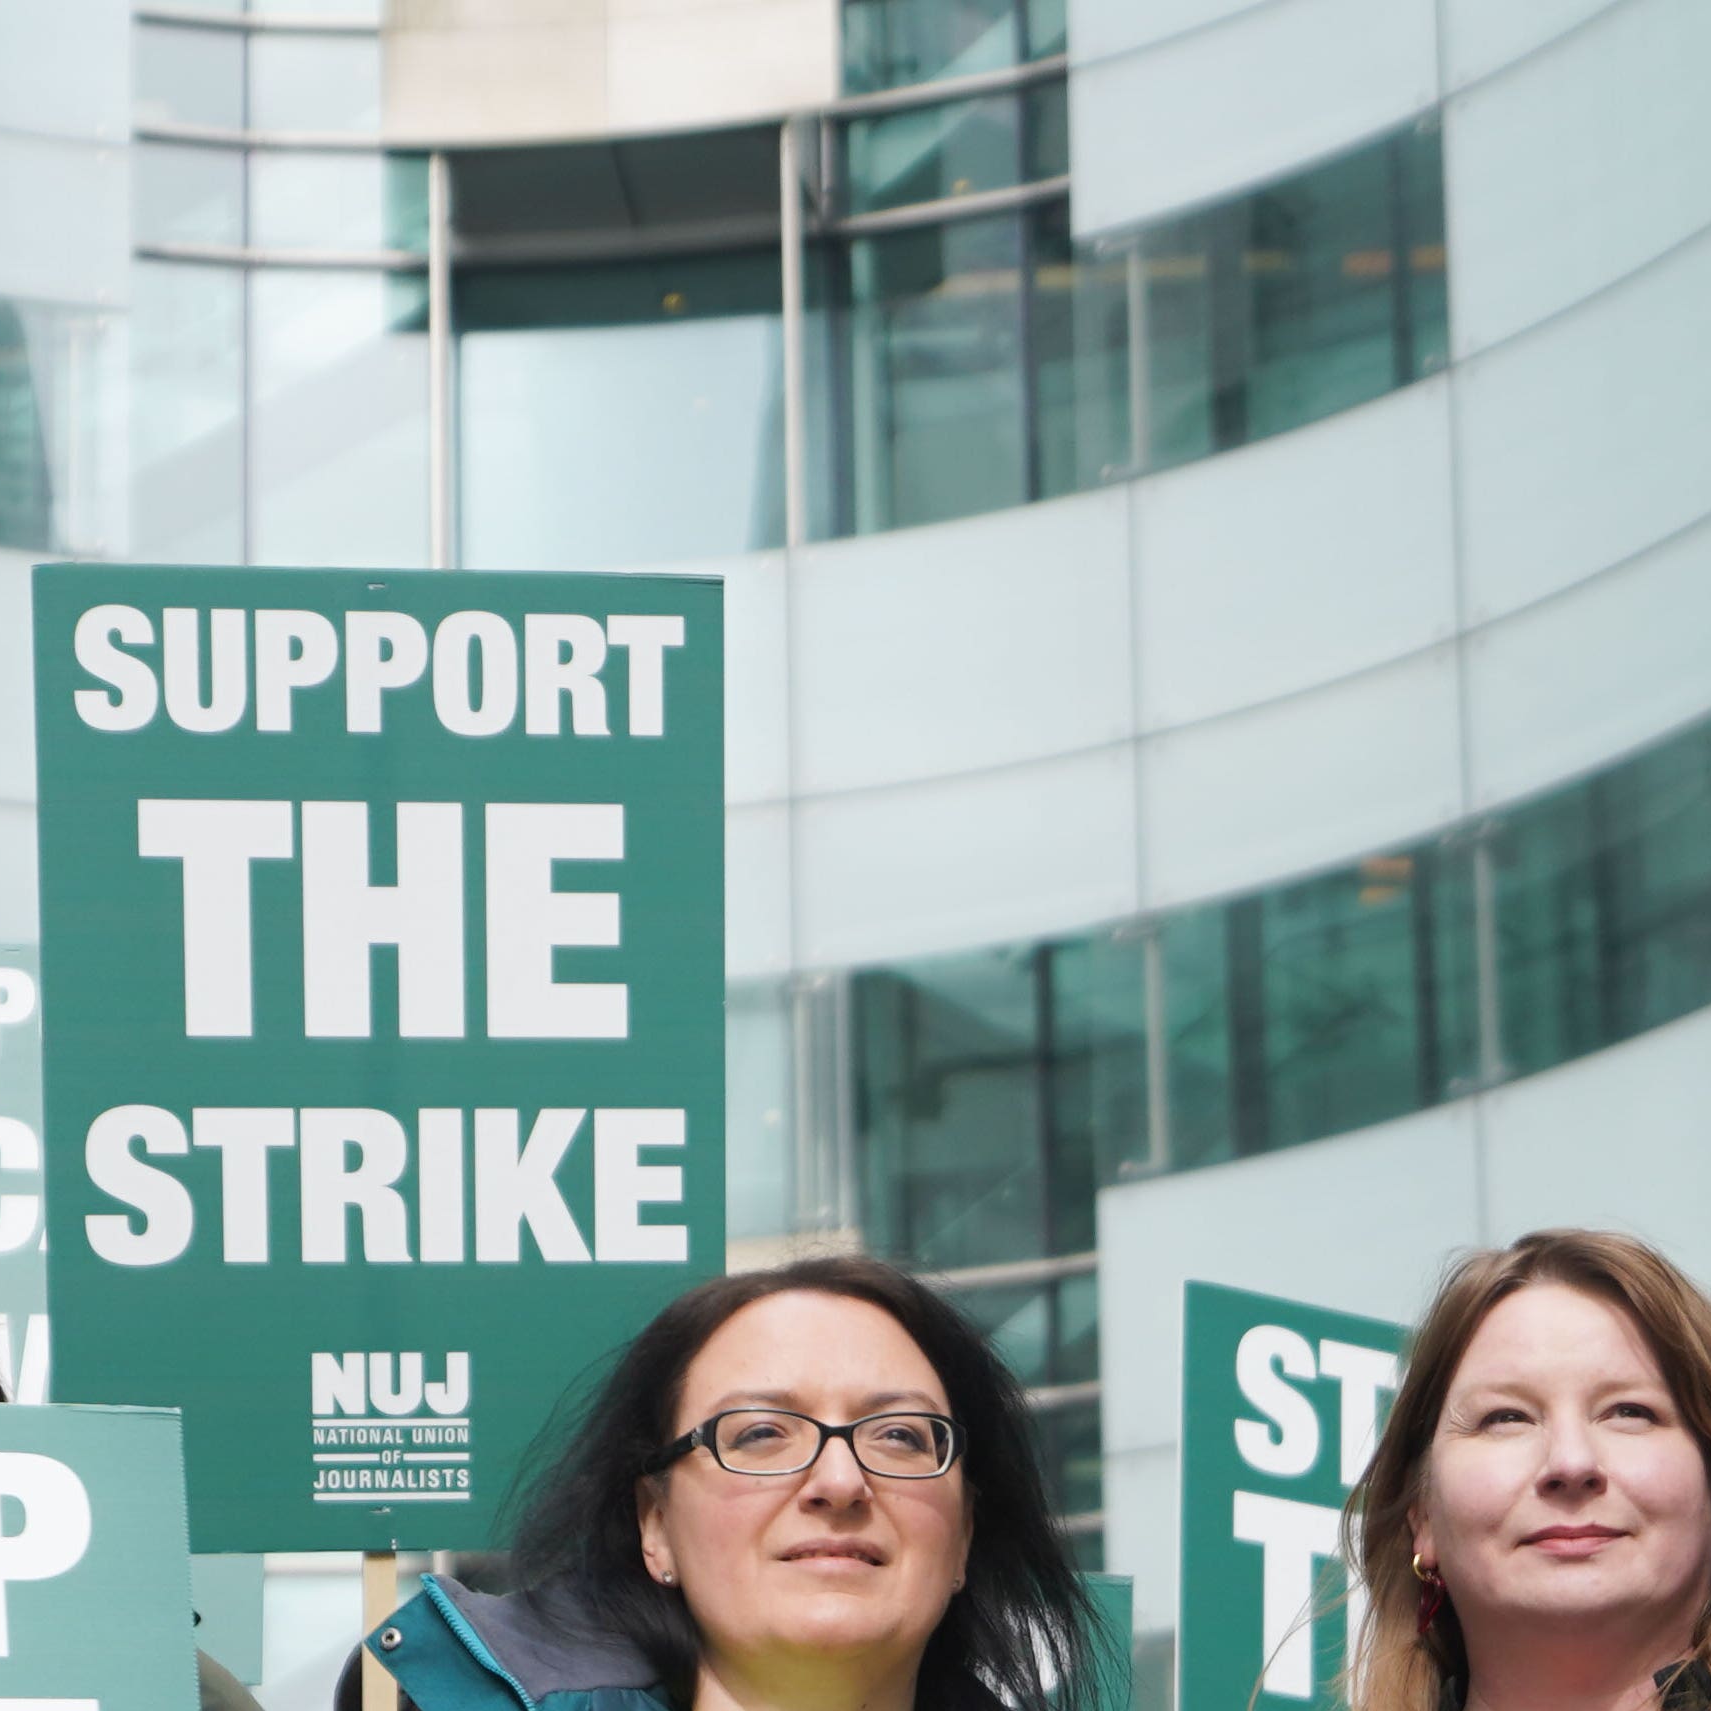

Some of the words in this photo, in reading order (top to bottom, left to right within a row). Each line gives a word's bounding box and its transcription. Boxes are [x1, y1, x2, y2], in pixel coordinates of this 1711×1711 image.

[73, 604, 685, 737] SUPPORT
[137, 798, 629, 1039] THE
[84, 1104, 689, 1267] STRIKE
[311, 1352, 469, 1415] NUJ
[313, 1428, 404, 1444] NATIONAL
[412, 1428, 469, 1443] UNION
[381, 1450, 401, 1464] OF
[313, 1469, 469, 1489] JOURNALISTS
